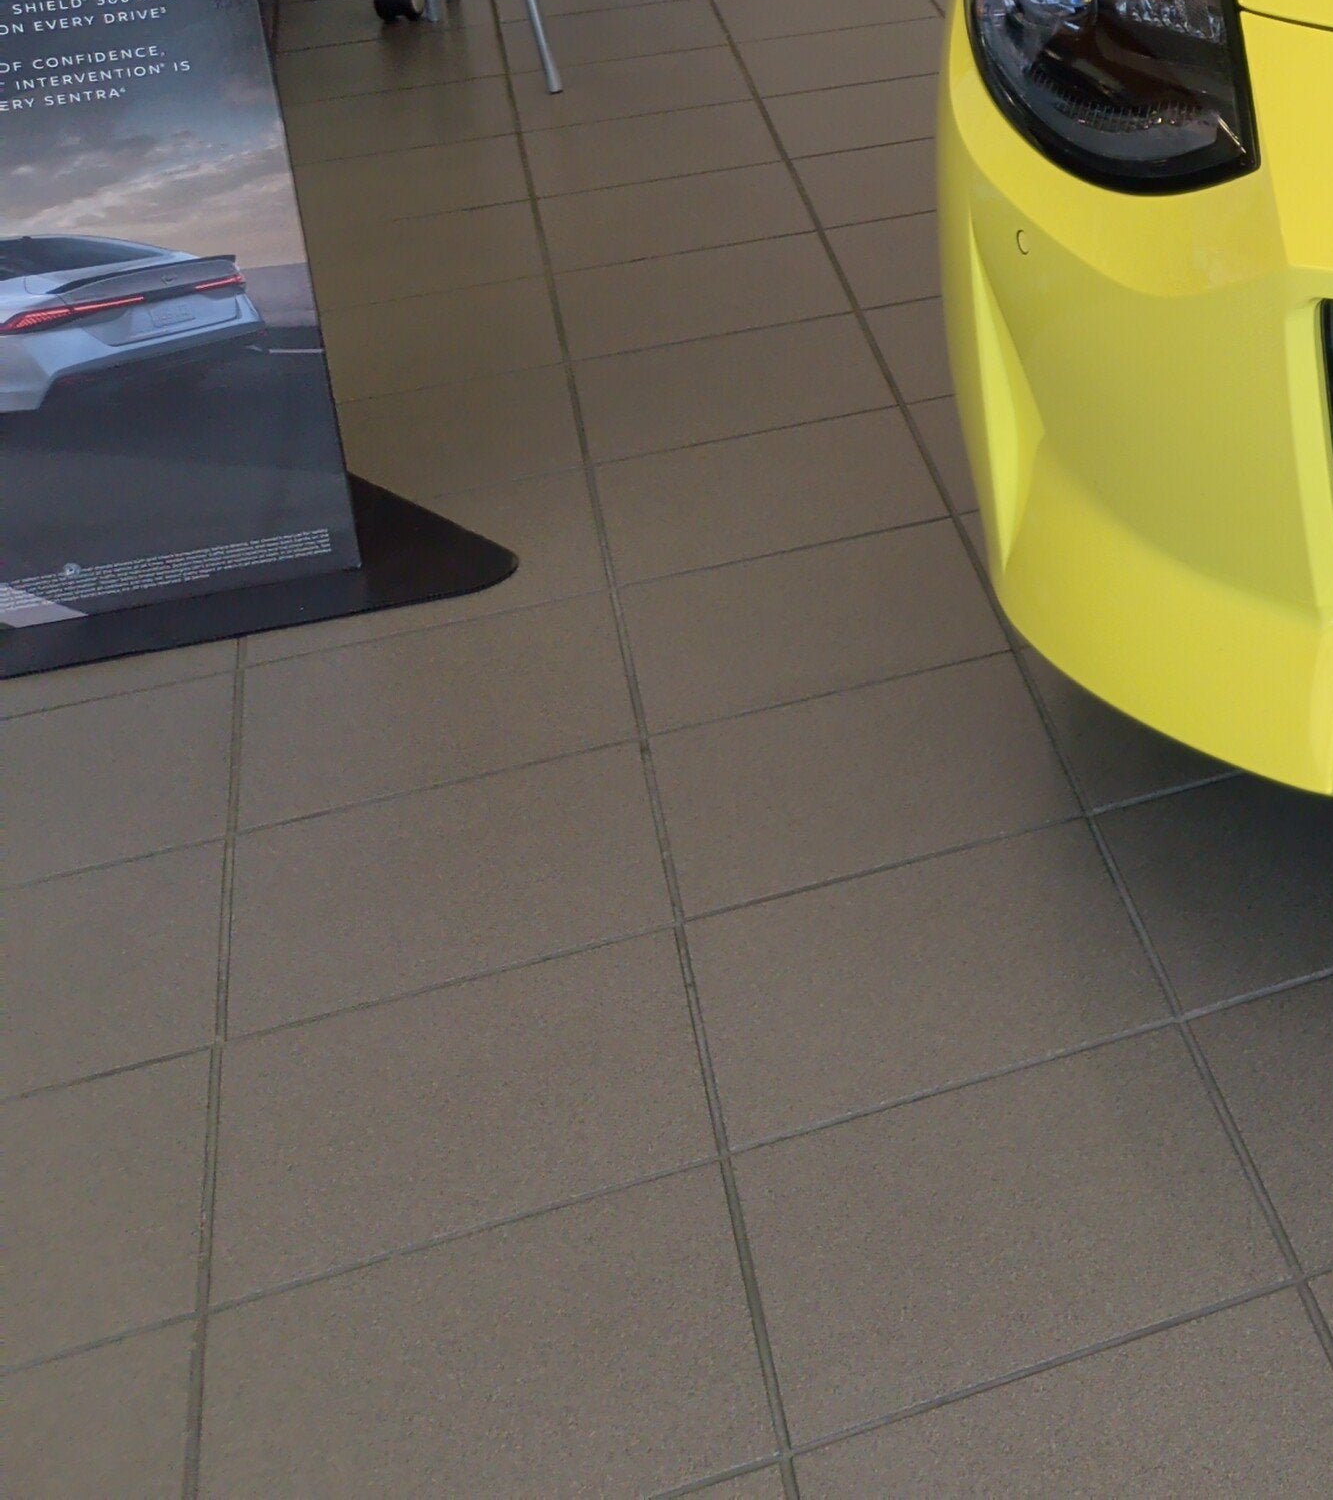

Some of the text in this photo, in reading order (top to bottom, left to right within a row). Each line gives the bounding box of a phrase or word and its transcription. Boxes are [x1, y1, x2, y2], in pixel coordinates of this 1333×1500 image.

[0, 23, 24, 35] ON
[33, 15, 94, 32] EVERY
[0, 61, 22, 74] OF
[173, 60, 191, 73] IS
